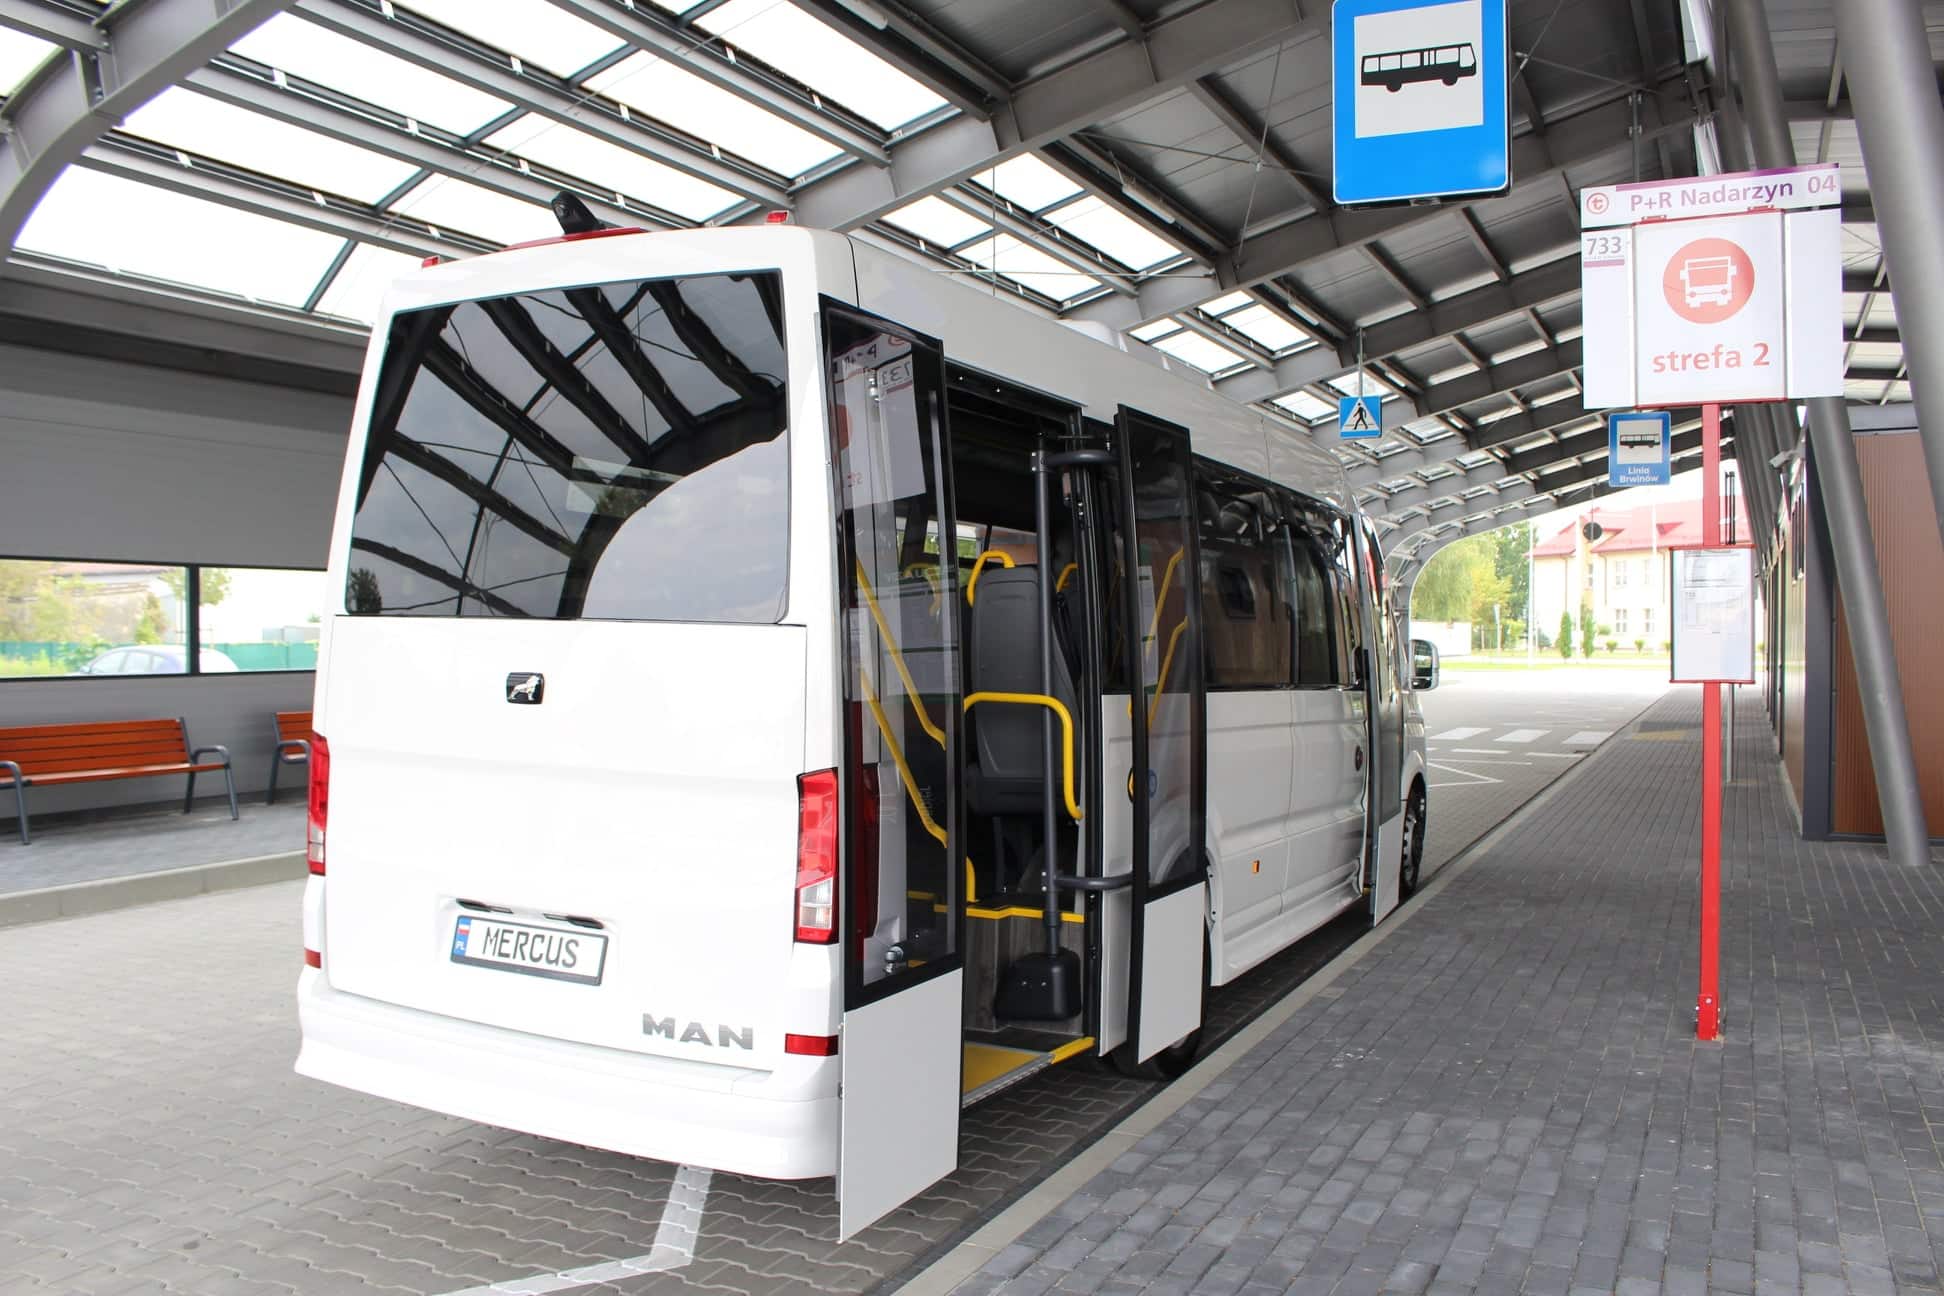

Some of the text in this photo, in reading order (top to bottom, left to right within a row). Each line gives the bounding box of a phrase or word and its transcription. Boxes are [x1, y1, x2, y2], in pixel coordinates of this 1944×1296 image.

[1631, 175, 1837, 211] P+R Nadarzyn 04
[1586, 236, 1622, 255] 733
[1653, 342, 1770, 373] strefa 2
[482, 927, 580, 968] MERCUS
[642, 1013, 754, 1050] MAN
